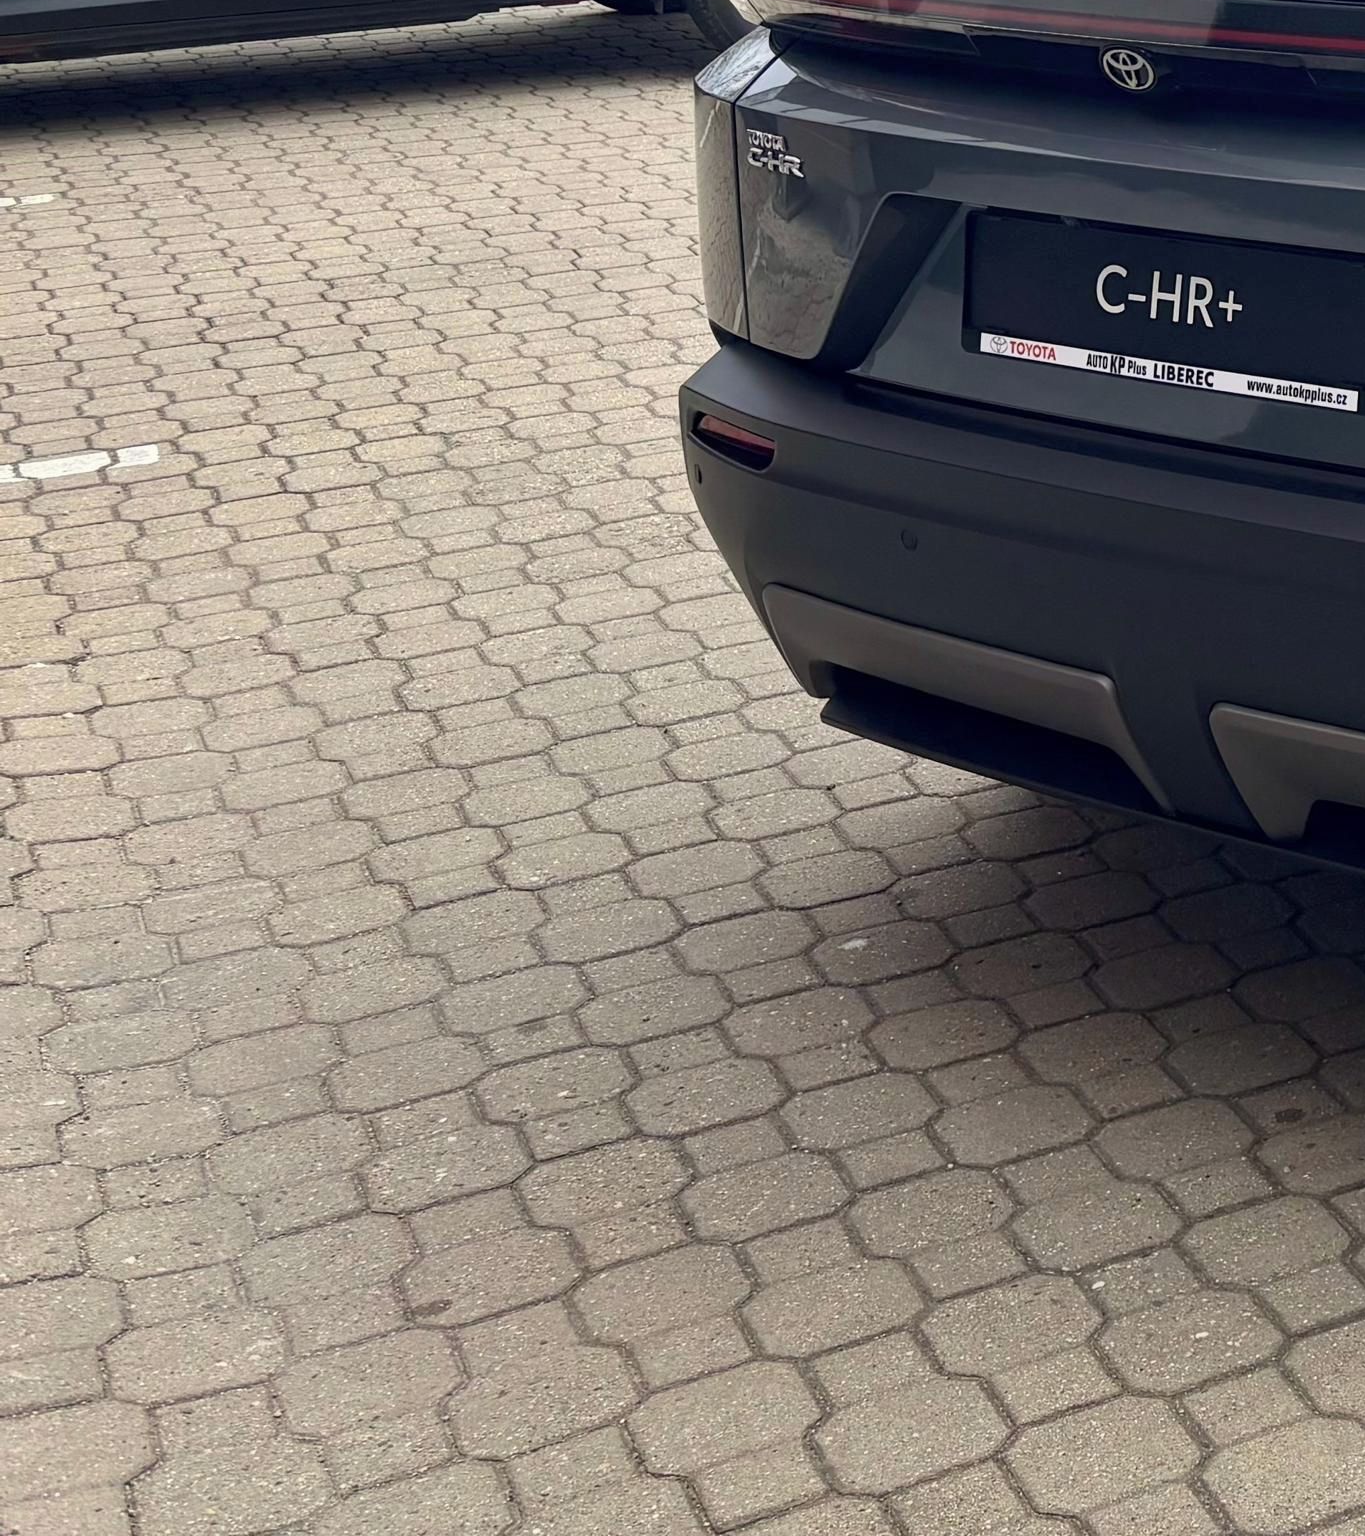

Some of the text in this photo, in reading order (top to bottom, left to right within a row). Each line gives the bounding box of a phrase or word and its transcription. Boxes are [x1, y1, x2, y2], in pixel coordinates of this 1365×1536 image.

[746, 128, 786, 152] TOYOTA
[1095, 263, 1243, 329] C-HR+
[1009, 340, 1057, 362] TOYOTA
[1085, 352, 1215, 388] AUTO KP Plus LIBEREC
[1246, 379, 1348, 406] www.autokpplus.cz
